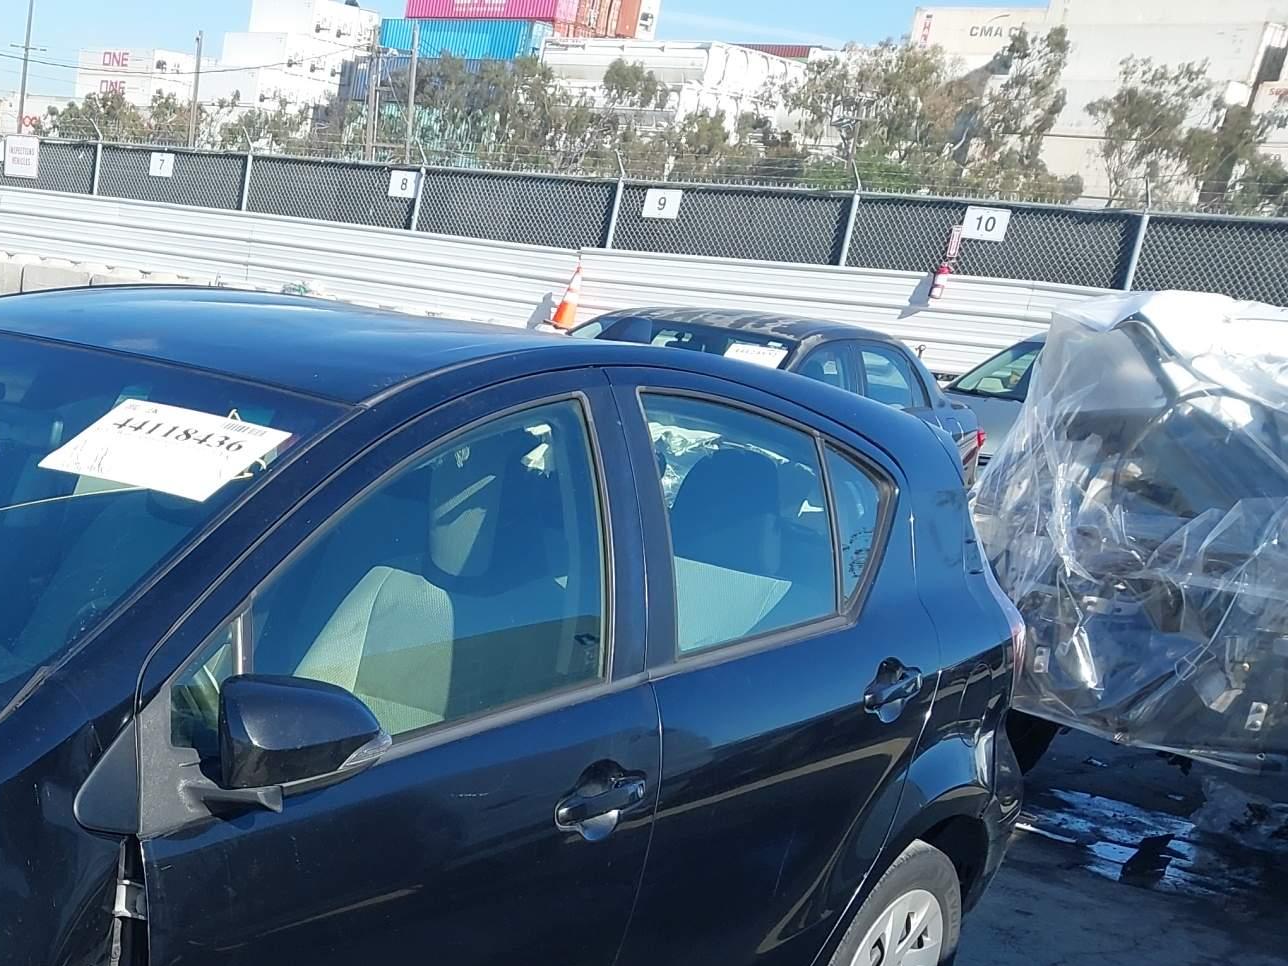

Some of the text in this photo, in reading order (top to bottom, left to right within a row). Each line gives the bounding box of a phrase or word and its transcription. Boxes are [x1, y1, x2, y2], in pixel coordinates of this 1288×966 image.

[969, 25, 1003, 38] CMA
[101, 51, 130, 68] ONE
[159, 158, 165, 171] 7
[400, 177, 408, 191] 8
[656, 196, 667, 211] 9
[976, 215, 997, 232] 10
[112, 416, 244, 452] 44118436
